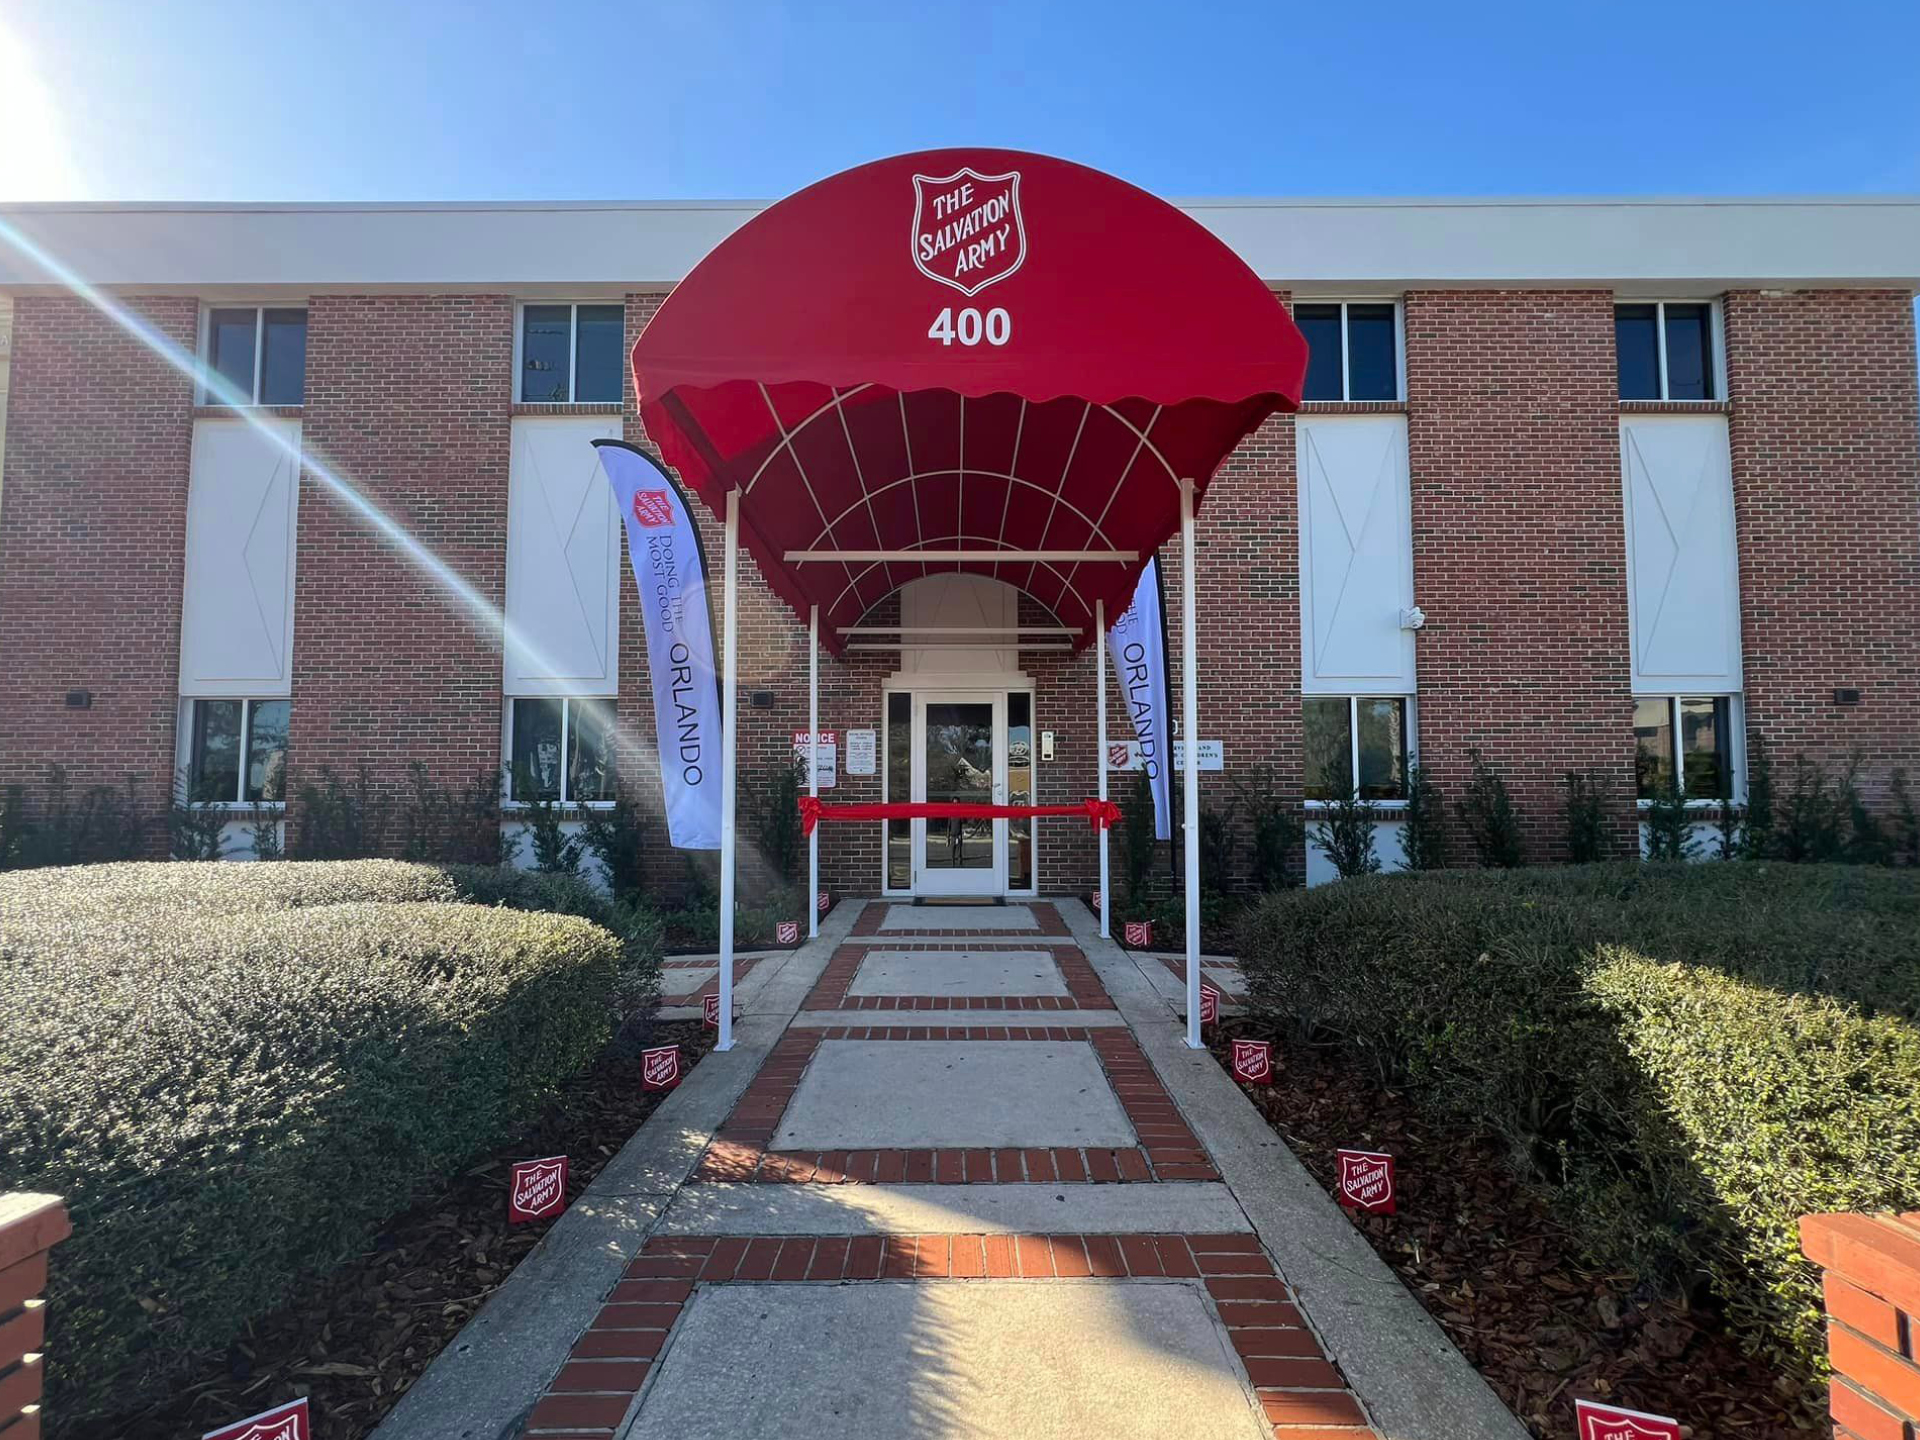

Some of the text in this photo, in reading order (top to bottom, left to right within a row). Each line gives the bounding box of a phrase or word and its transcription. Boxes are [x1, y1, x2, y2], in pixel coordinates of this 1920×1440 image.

[934, 183, 975, 220] THE
[920, 189, 1010, 262] SALVATION
[954, 223, 1010, 278] ARMY
[928, 307, 1011, 346] 400
[646, 536, 675, 633] MOST GOOD
[659, 535, 683, 623] DOING THE
[669, 643, 703, 786] ORLANDO
[1123, 643, 1158, 780] ORLANDO
[795, 733, 835, 743] NOICE
[651, 1055, 662, 1067] THE
[1238, 1050, 1264, 1070] SALVATION
[1241, 1048, 1253, 1059] THE
[647, 1055, 673, 1079] SALVATION
[656, 1064, 673, 1081] ARMY
[1247, 1060, 1264, 1074] ARMY
[524, 1170, 543, 1188] THE
[1347, 1166, 1384, 1192] SALVATION
[1351, 1162, 1369, 1177] THE
[516, 1169, 557, 1205] SALVATION
[530, 1183, 556, 1209] ARMY
[1361, 1180, 1383, 1200] ARMY
